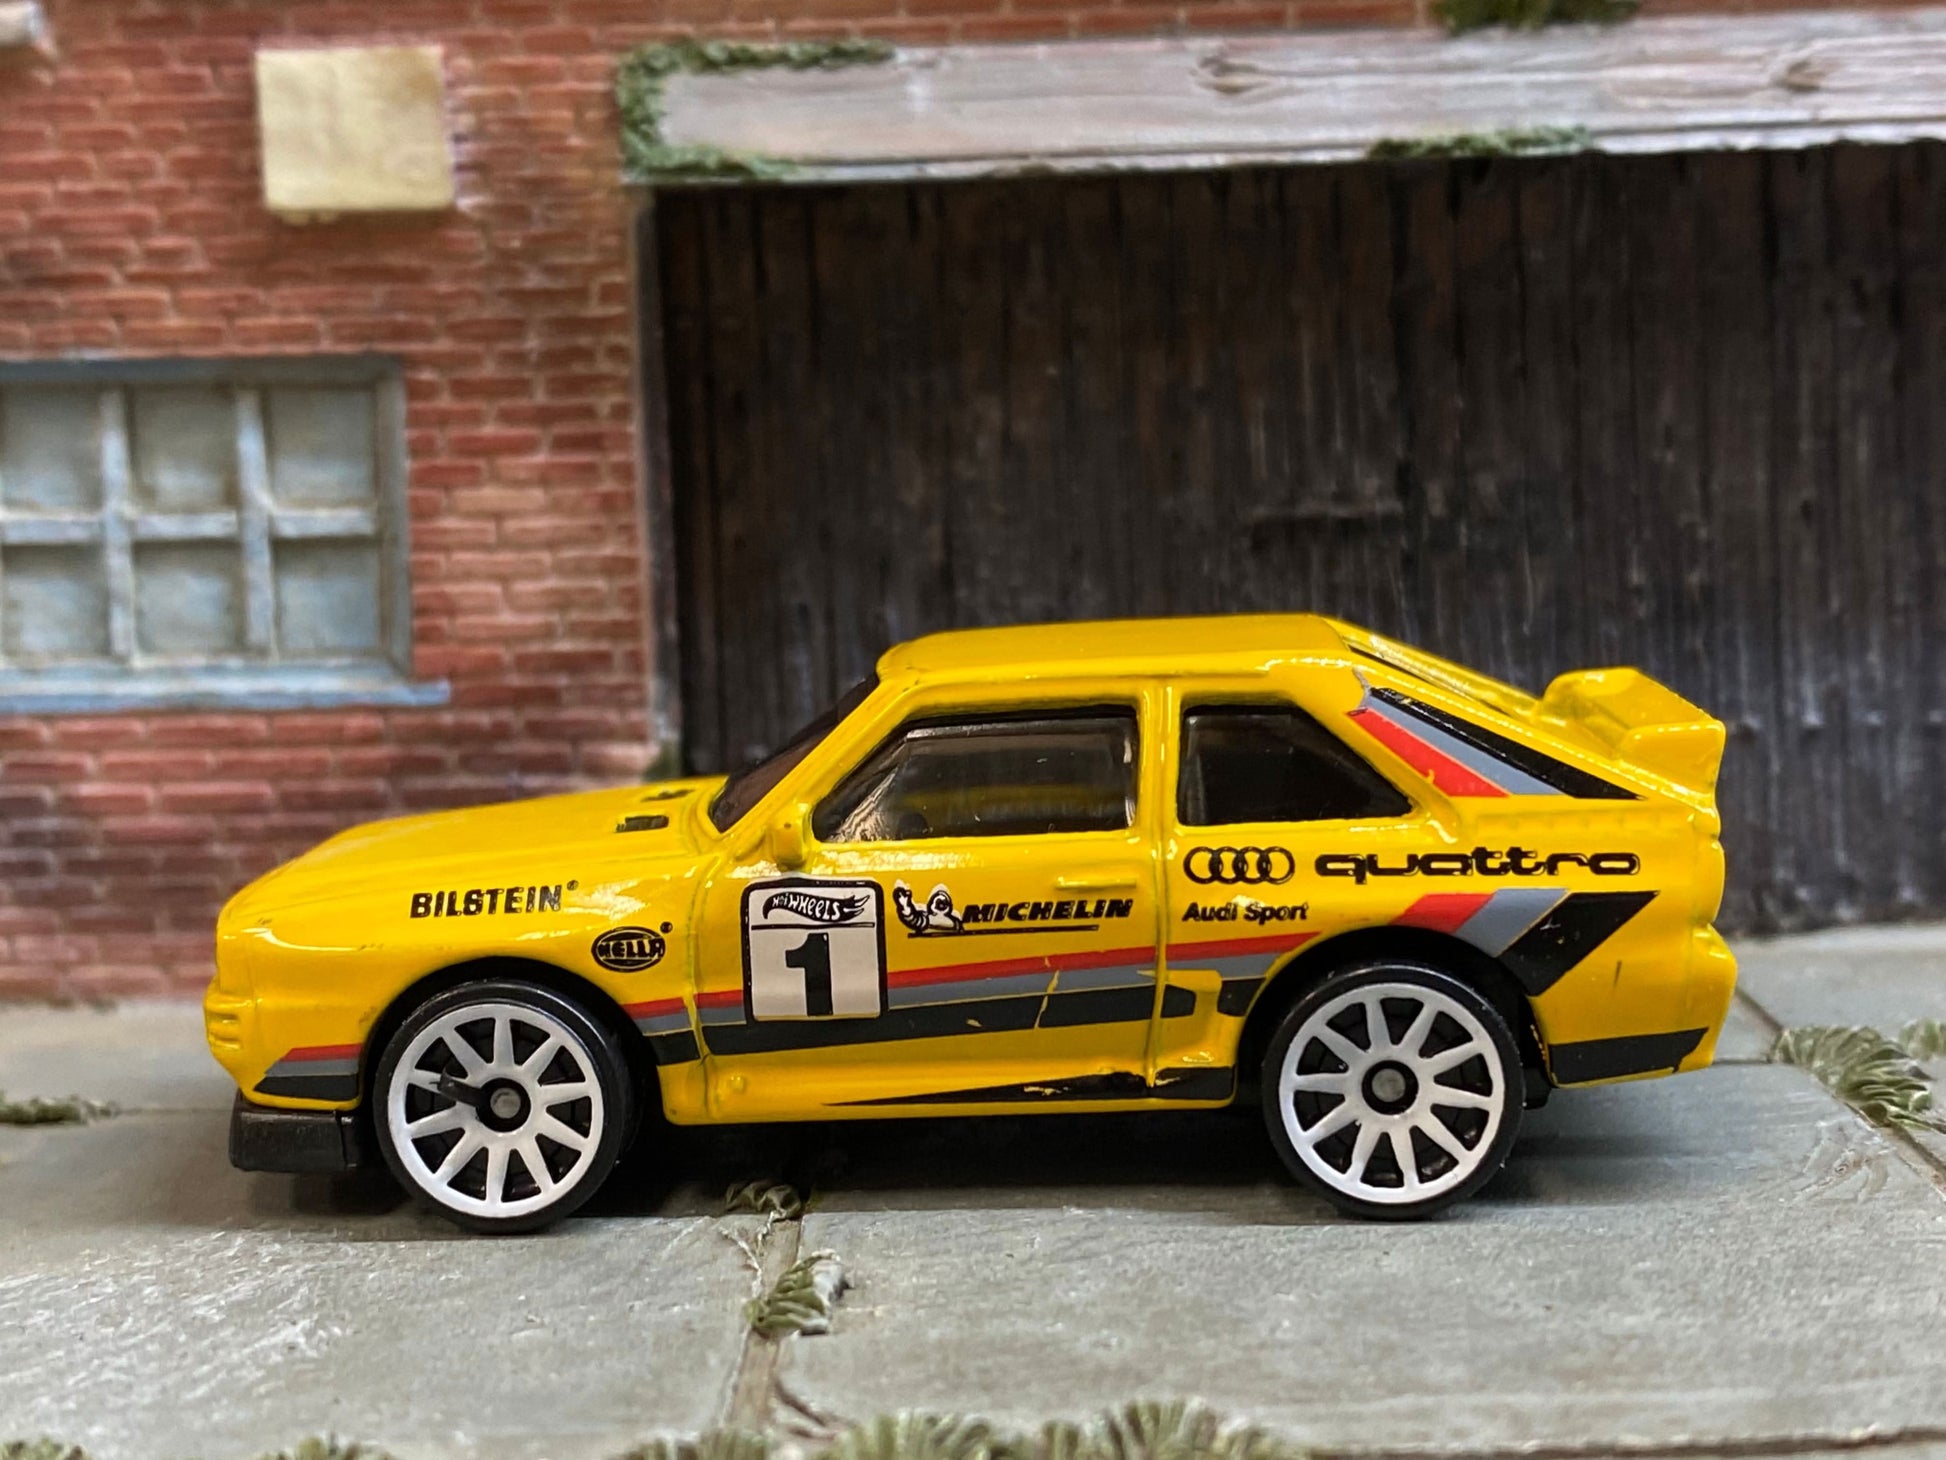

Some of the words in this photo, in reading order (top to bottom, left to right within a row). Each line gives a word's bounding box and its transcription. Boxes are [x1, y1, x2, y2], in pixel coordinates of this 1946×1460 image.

[1315, 847, 1641, 885] quattro
[410, 884, 562, 918] BILSTEIN
[962, 899, 1133, 924] MICHELIN
[1181, 901, 1239, 922] Audi
[1243, 901, 1309, 926] Sport
[597, 937, 665, 960] HELLA
[785, 932, 834, 1017] 1
